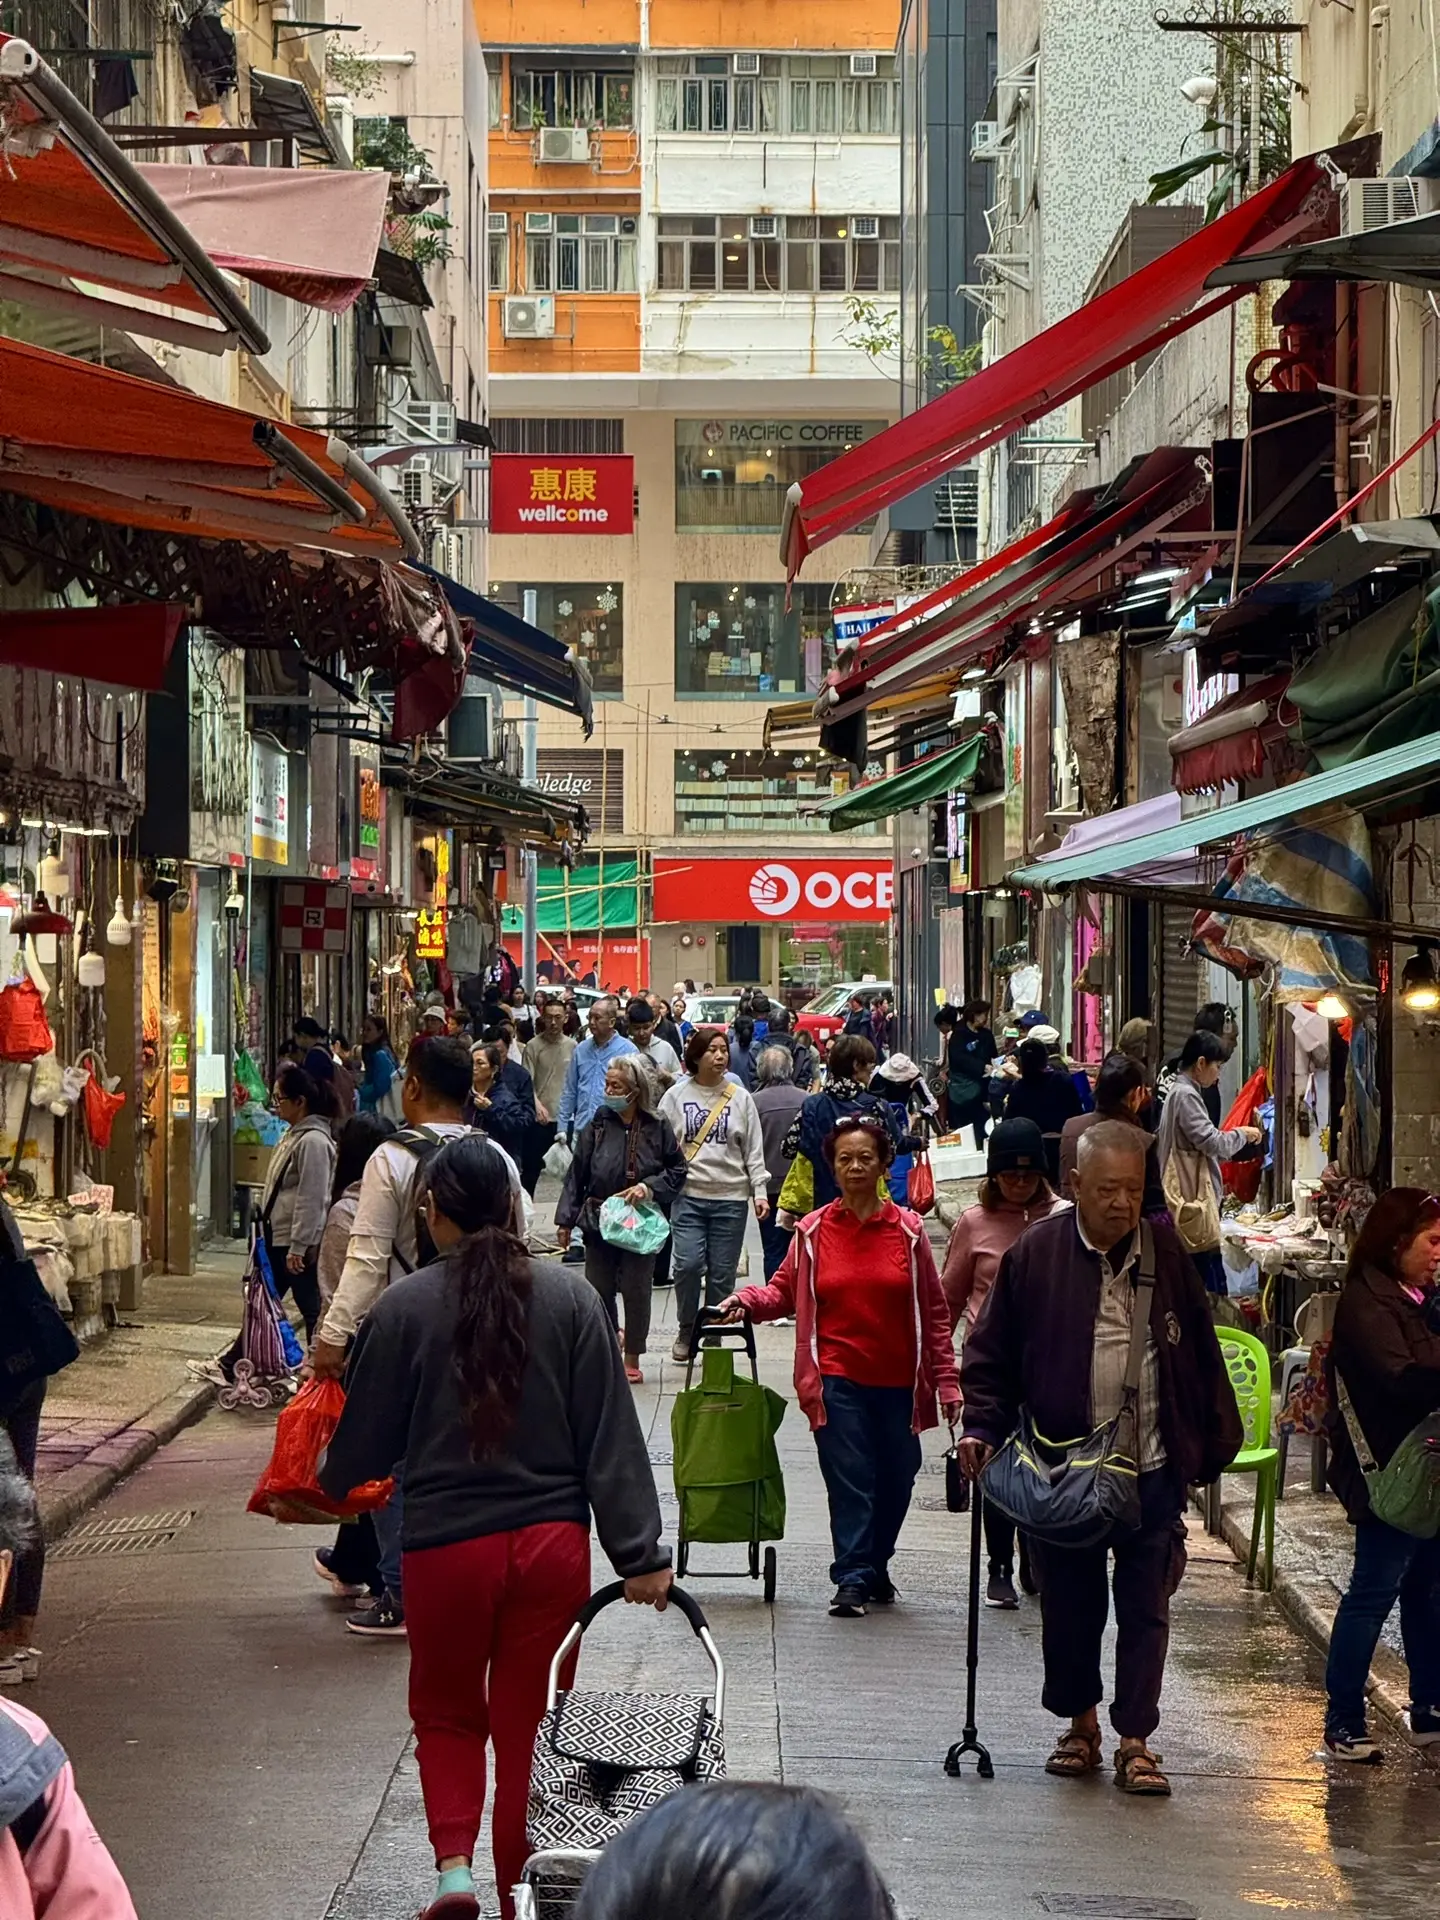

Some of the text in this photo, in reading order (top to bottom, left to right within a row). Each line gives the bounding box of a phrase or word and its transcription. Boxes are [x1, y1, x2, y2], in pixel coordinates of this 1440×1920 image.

[729, 424, 863, 441] PACIFIC COFFEE
[530, 467, 597, 501] 惠康
[518, 504, 609, 522] wellcome
